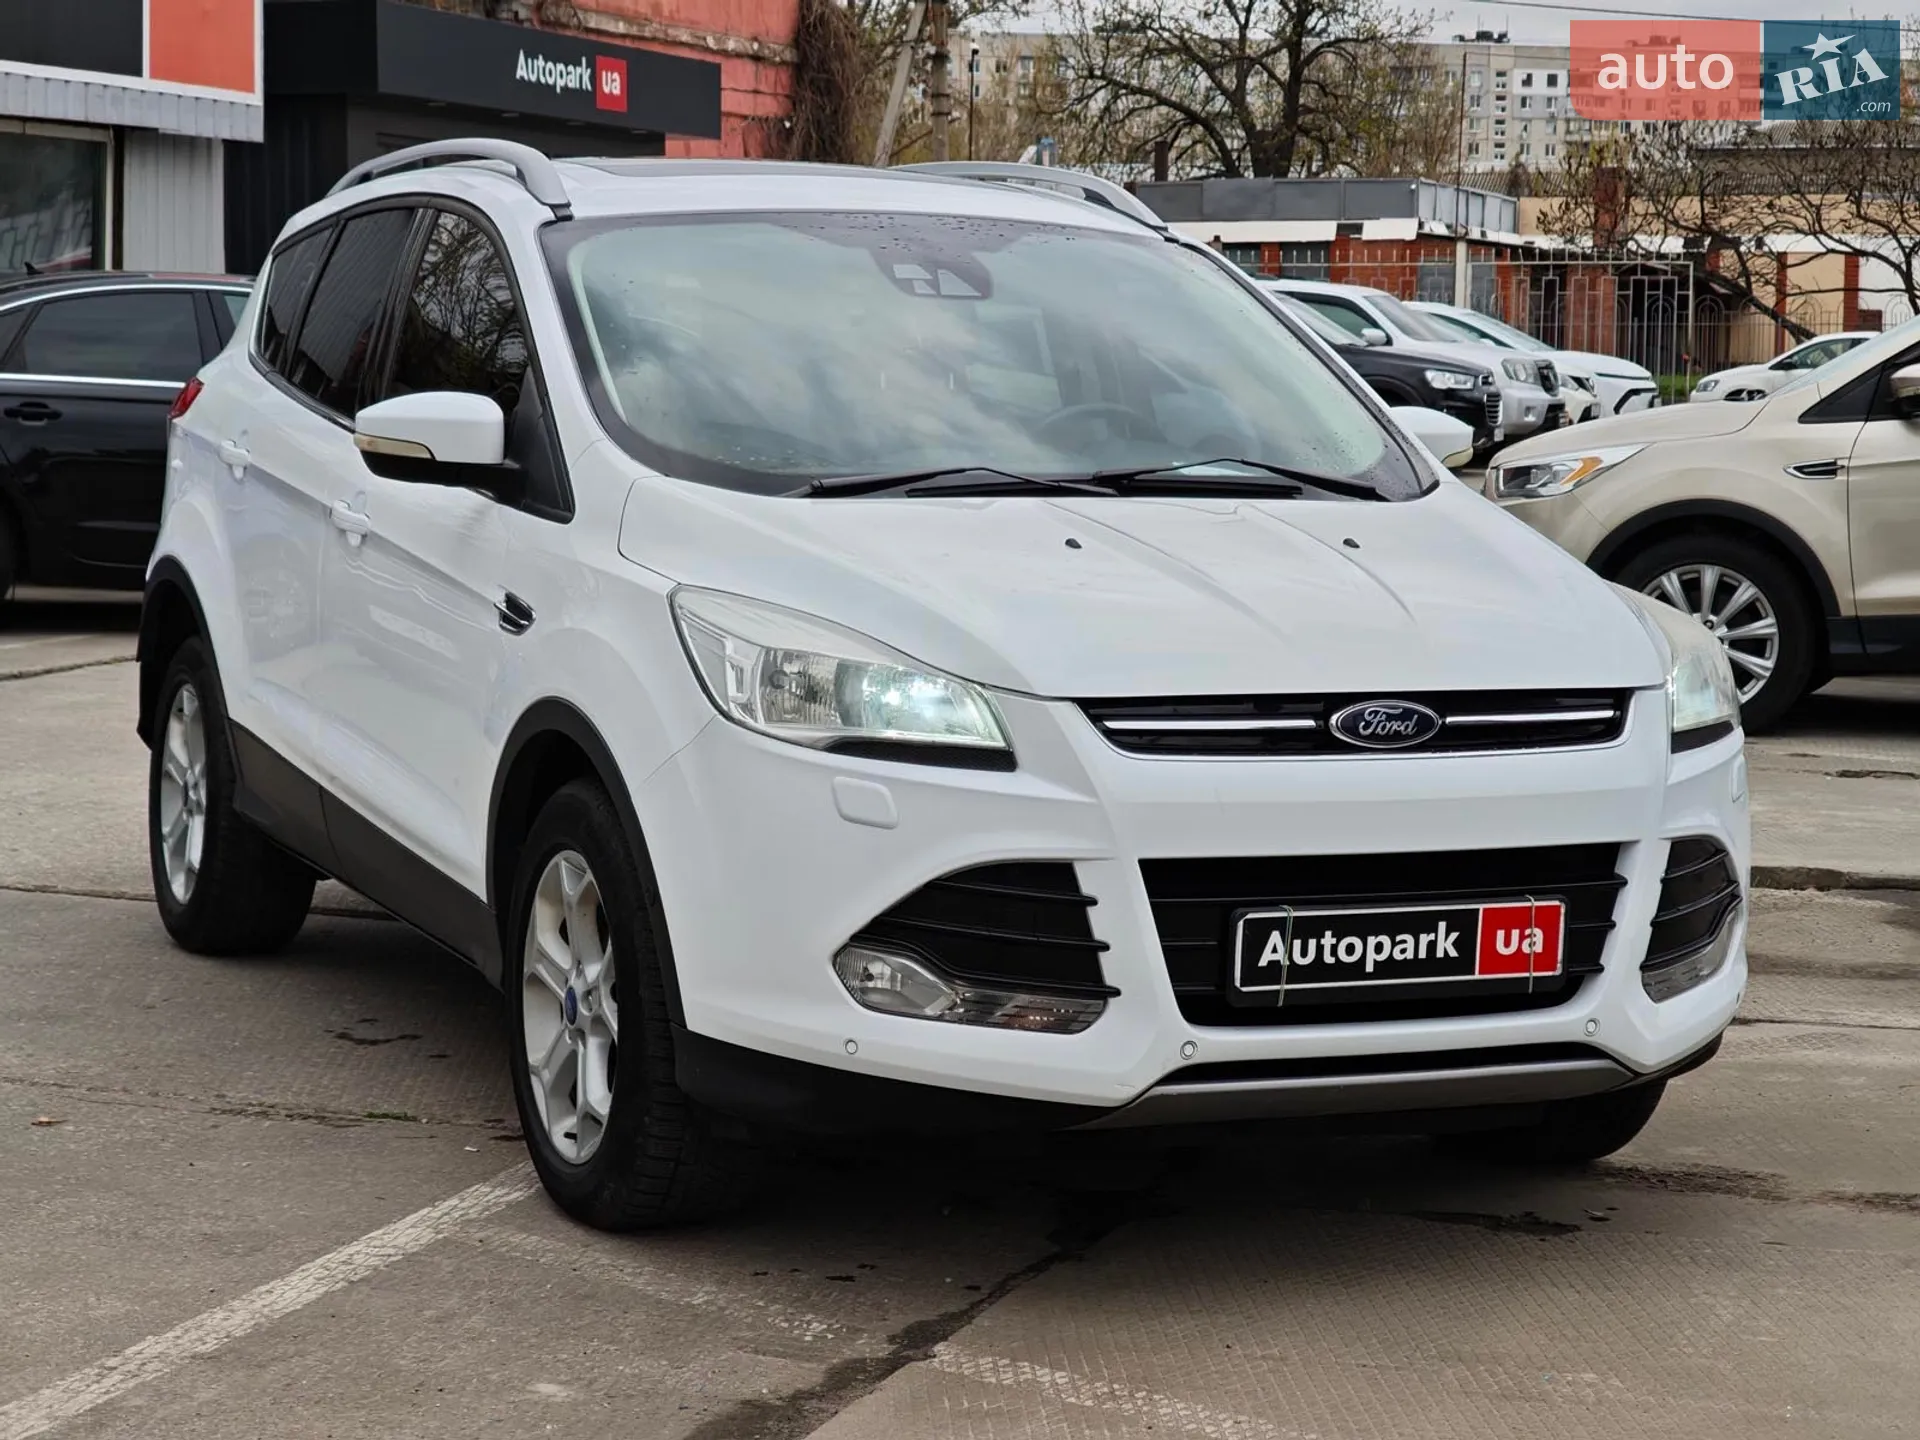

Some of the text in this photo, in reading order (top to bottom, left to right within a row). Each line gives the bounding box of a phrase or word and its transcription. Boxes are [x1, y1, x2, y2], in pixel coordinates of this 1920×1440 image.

[516, 49, 620, 96] Autopark ua
[1359, 707, 1418, 736] Ford
[1257, 921, 1543, 973] Autopark ua
